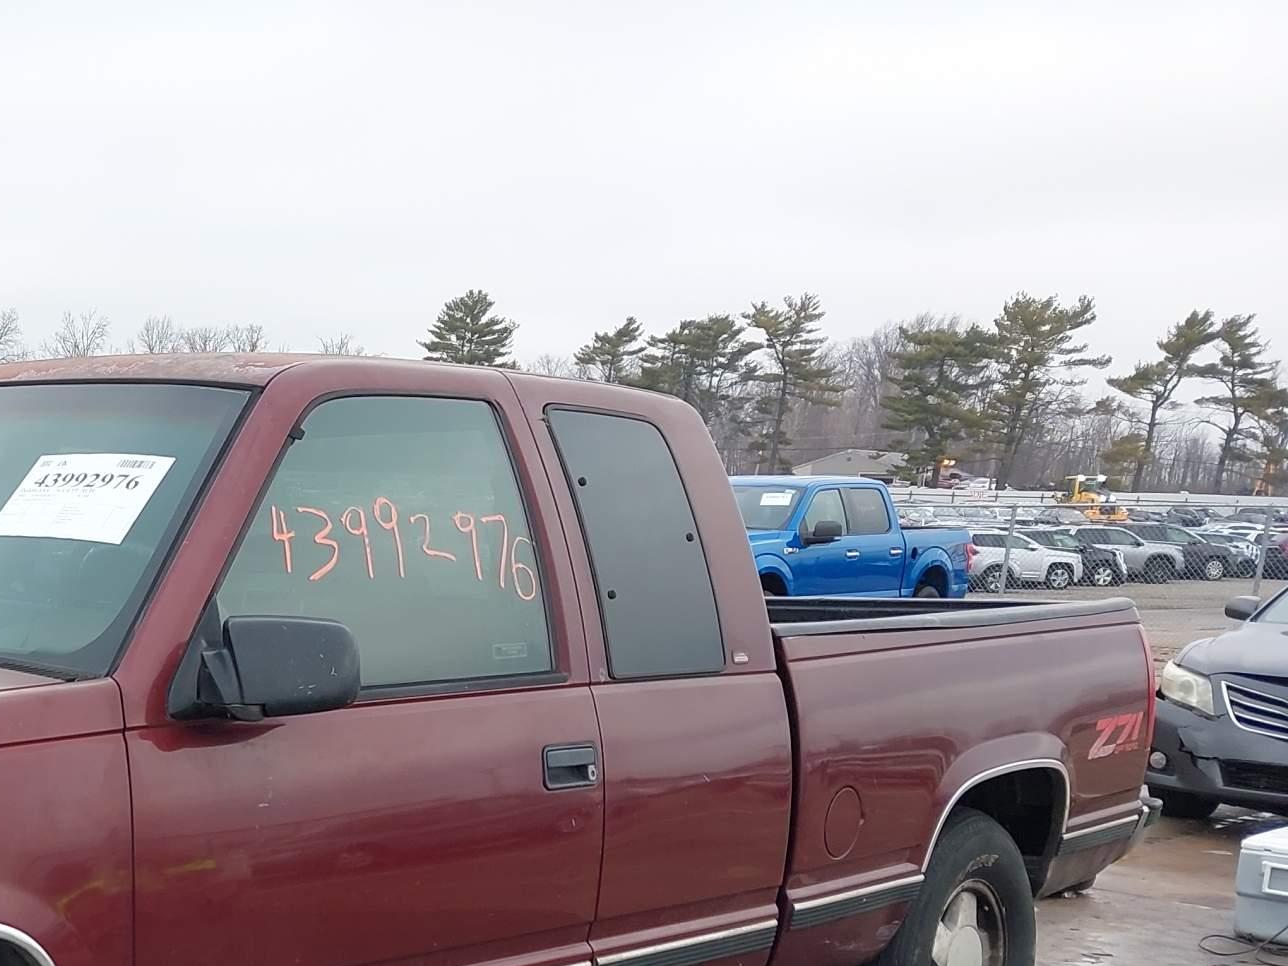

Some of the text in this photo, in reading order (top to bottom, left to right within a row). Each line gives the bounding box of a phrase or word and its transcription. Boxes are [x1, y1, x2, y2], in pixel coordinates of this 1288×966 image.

[34, 472, 144, 490] 43992976
[270, 496, 537, 601] 43992976
[1088, 711, 1144, 760] Z71
